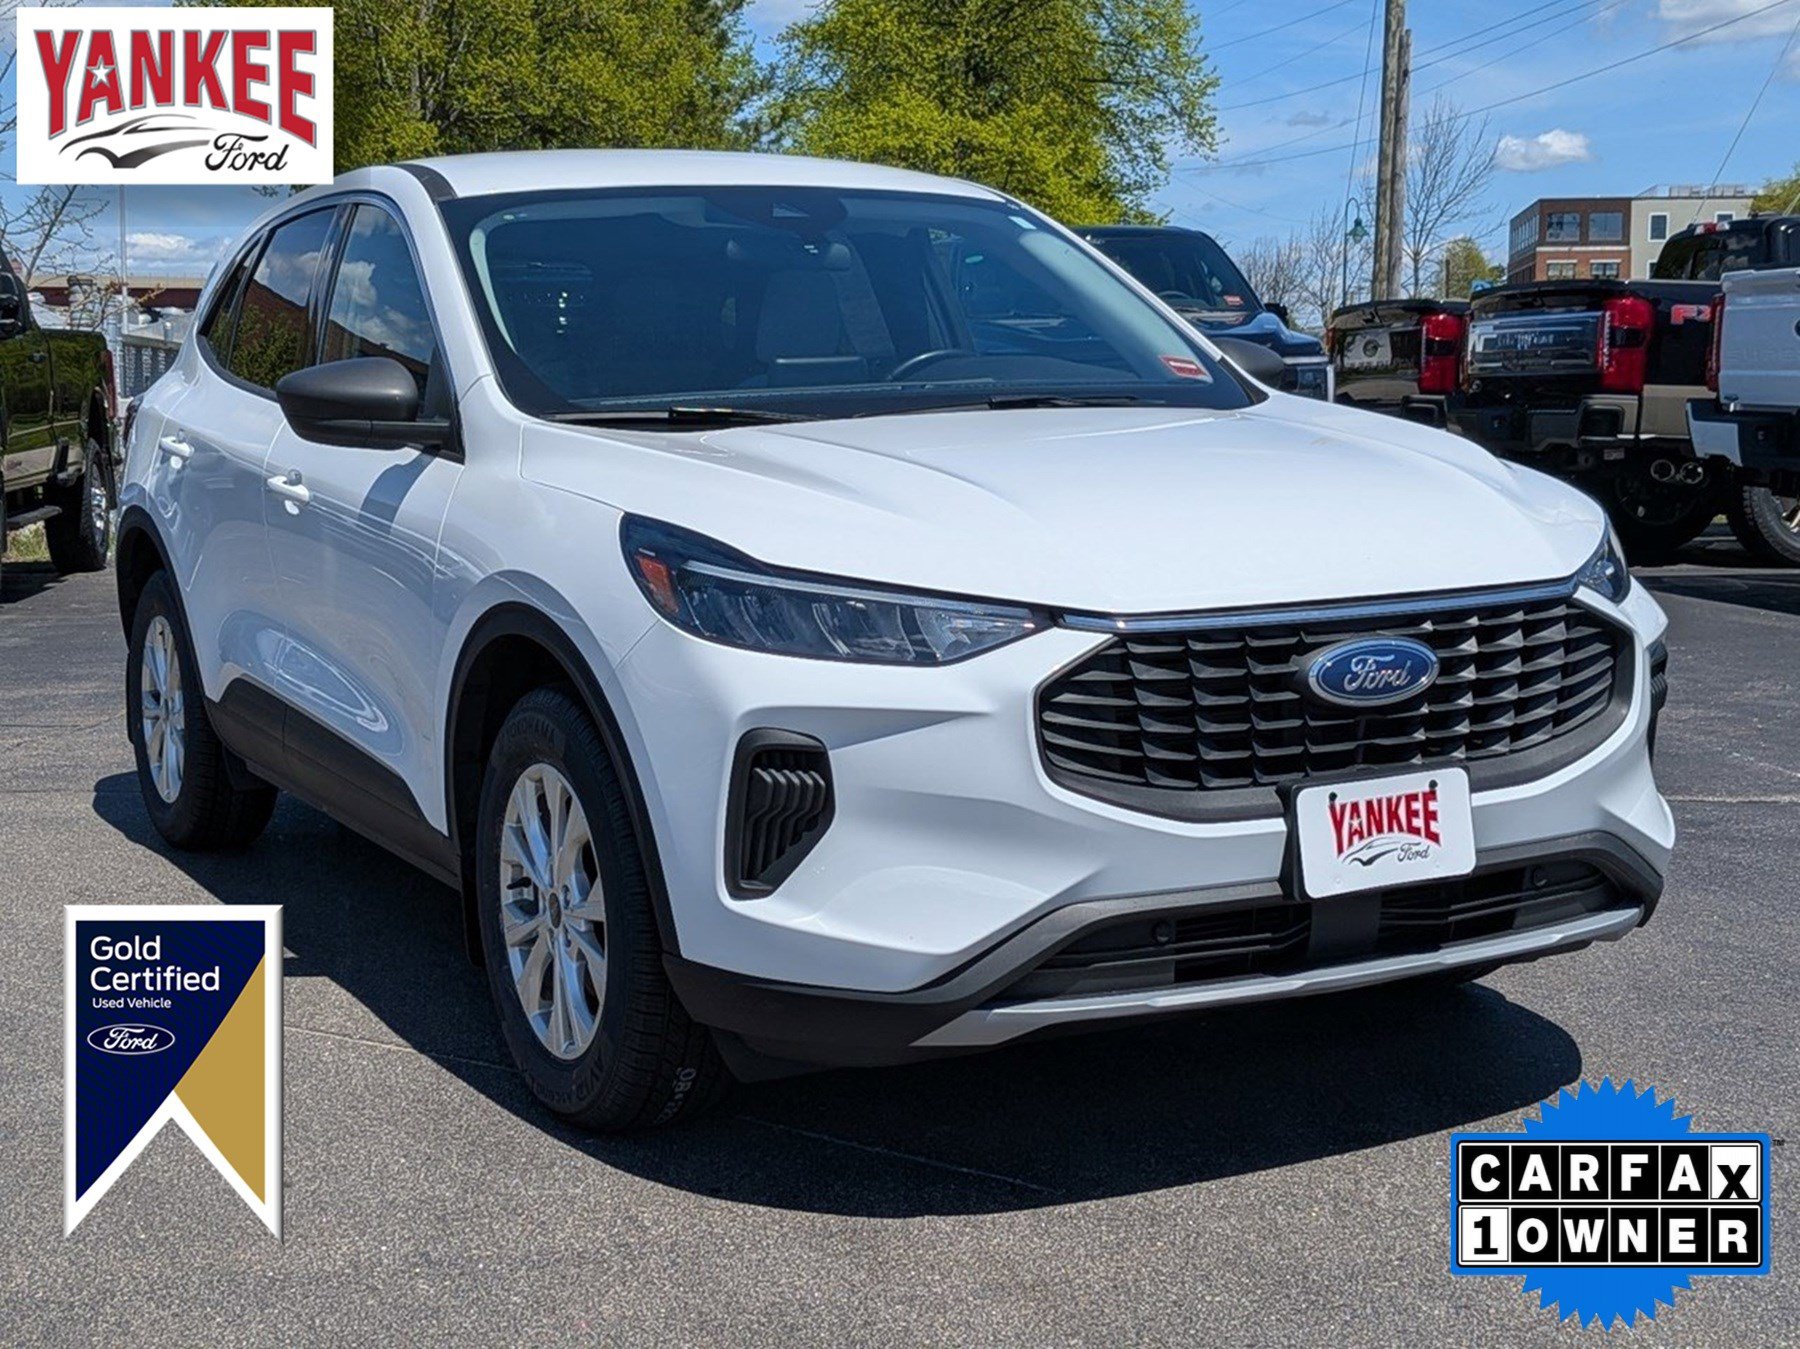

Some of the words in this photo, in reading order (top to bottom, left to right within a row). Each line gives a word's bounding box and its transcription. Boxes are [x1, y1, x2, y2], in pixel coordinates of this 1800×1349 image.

[1343, 654, 1411, 691] Ford
[1328, 790, 1441, 859] YANKEE
[1397, 842, 1430, 862] Ford
